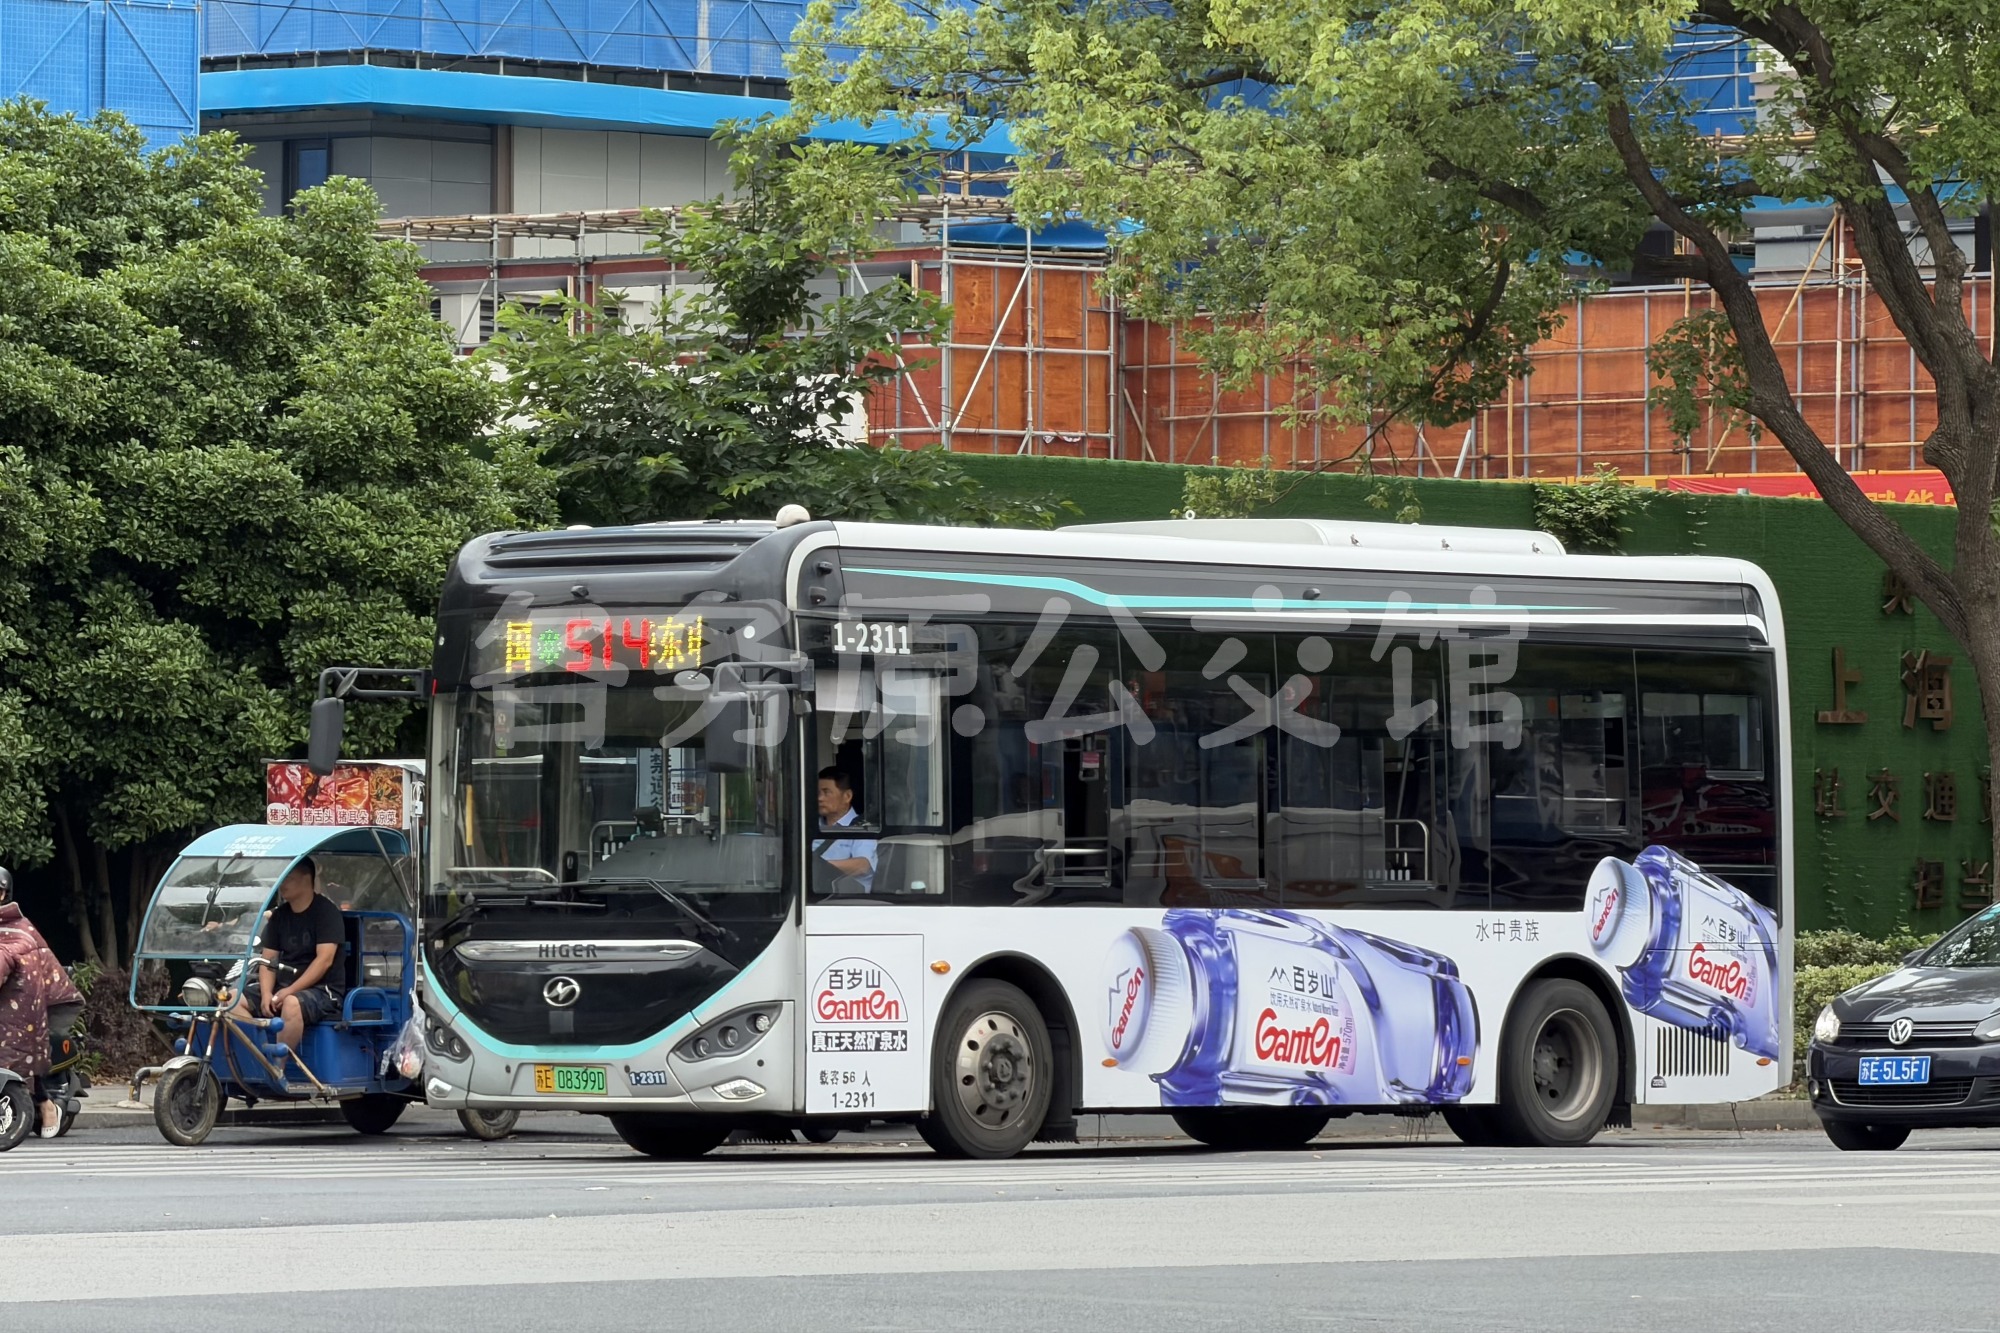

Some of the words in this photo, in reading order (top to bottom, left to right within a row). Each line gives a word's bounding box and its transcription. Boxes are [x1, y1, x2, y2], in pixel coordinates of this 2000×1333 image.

[565, 617, 650, 672] 514
[834, 622, 911, 655] 1-2311
[269, 808, 300, 822] 猪头肉
[303, 808, 334, 823] 猪舌头
[338, 809, 369, 824] 猪耳朵
[376, 810, 397, 825] 凉菜
[1476, 918, 1539, 942] 水中贵族
[538, 943, 598, 958] HIGER
[828, 968, 881, 990] 百岁山
[1293, 965, 1334, 999] 百岁山
[1688, 943, 1747, 1000] Ganten
[817, 989, 900, 1020] Ganten
[813, 1031, 907, 1051] 真正天然矿泉水
[1255, 1007, 1341, 1068] Ganten
